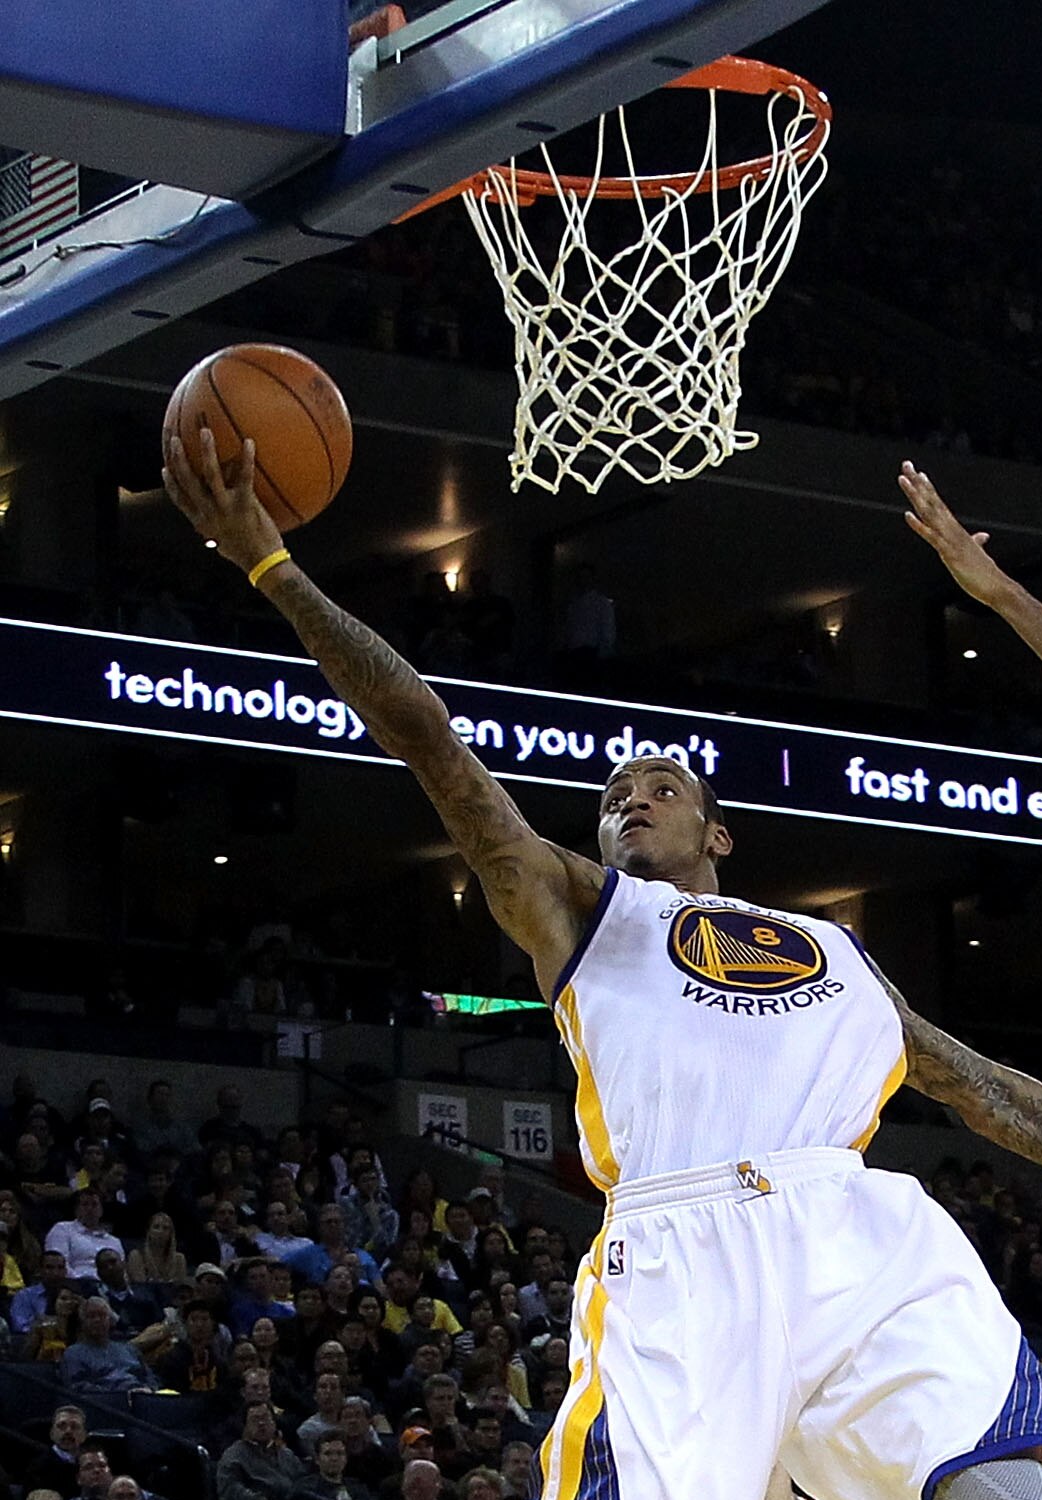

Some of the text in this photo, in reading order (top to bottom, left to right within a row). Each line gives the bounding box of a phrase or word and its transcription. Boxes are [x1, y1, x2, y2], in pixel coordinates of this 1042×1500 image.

[513, 724, 594, 761] you
[845, 756, 930, 803] fast
[938, 776, 1019, 815] and
[752, 927, 782, 946] 8
[681, 978, 845, 1016] WARRIORS
[428, 1102, 457, 1118] SEC
[513, 1108, 542, 1123] SEC
[510, 1127, 548, 1154] 116
